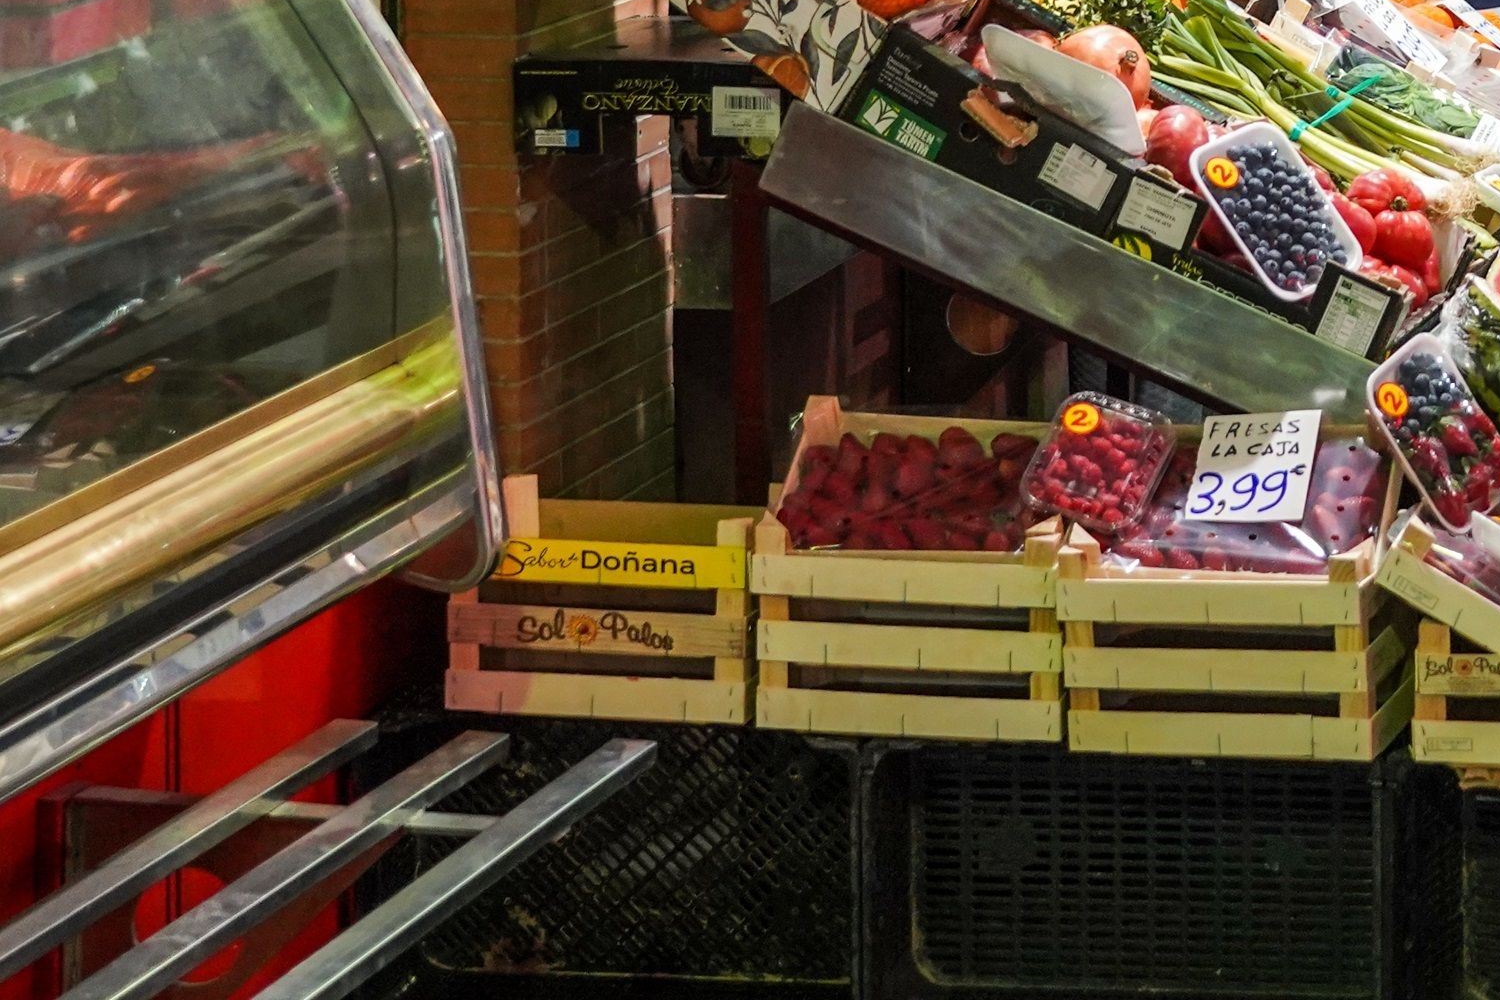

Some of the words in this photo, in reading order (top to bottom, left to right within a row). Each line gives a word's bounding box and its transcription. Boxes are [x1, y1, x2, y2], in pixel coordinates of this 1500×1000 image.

[901, 117, 935, 145] TÜMEN
[1213, 162, 1233, 182] 2
[1383, 390, 1404, 412] 2
[1209, 420, 1300, 439] FRESAS
[1211, 444, 1237, 457] LA
[1247, 441, 1299, 456] CAJA
[1190, 464, 1306, 515] 3,99€
[495, 540, 573, 577] Sabor
[581, 550, 695, 575] Doñana
[517, 607, 566, 643] Sol
[600, 611, 674, 651] Palos
[1426, 656, 1453, 679] Sol
